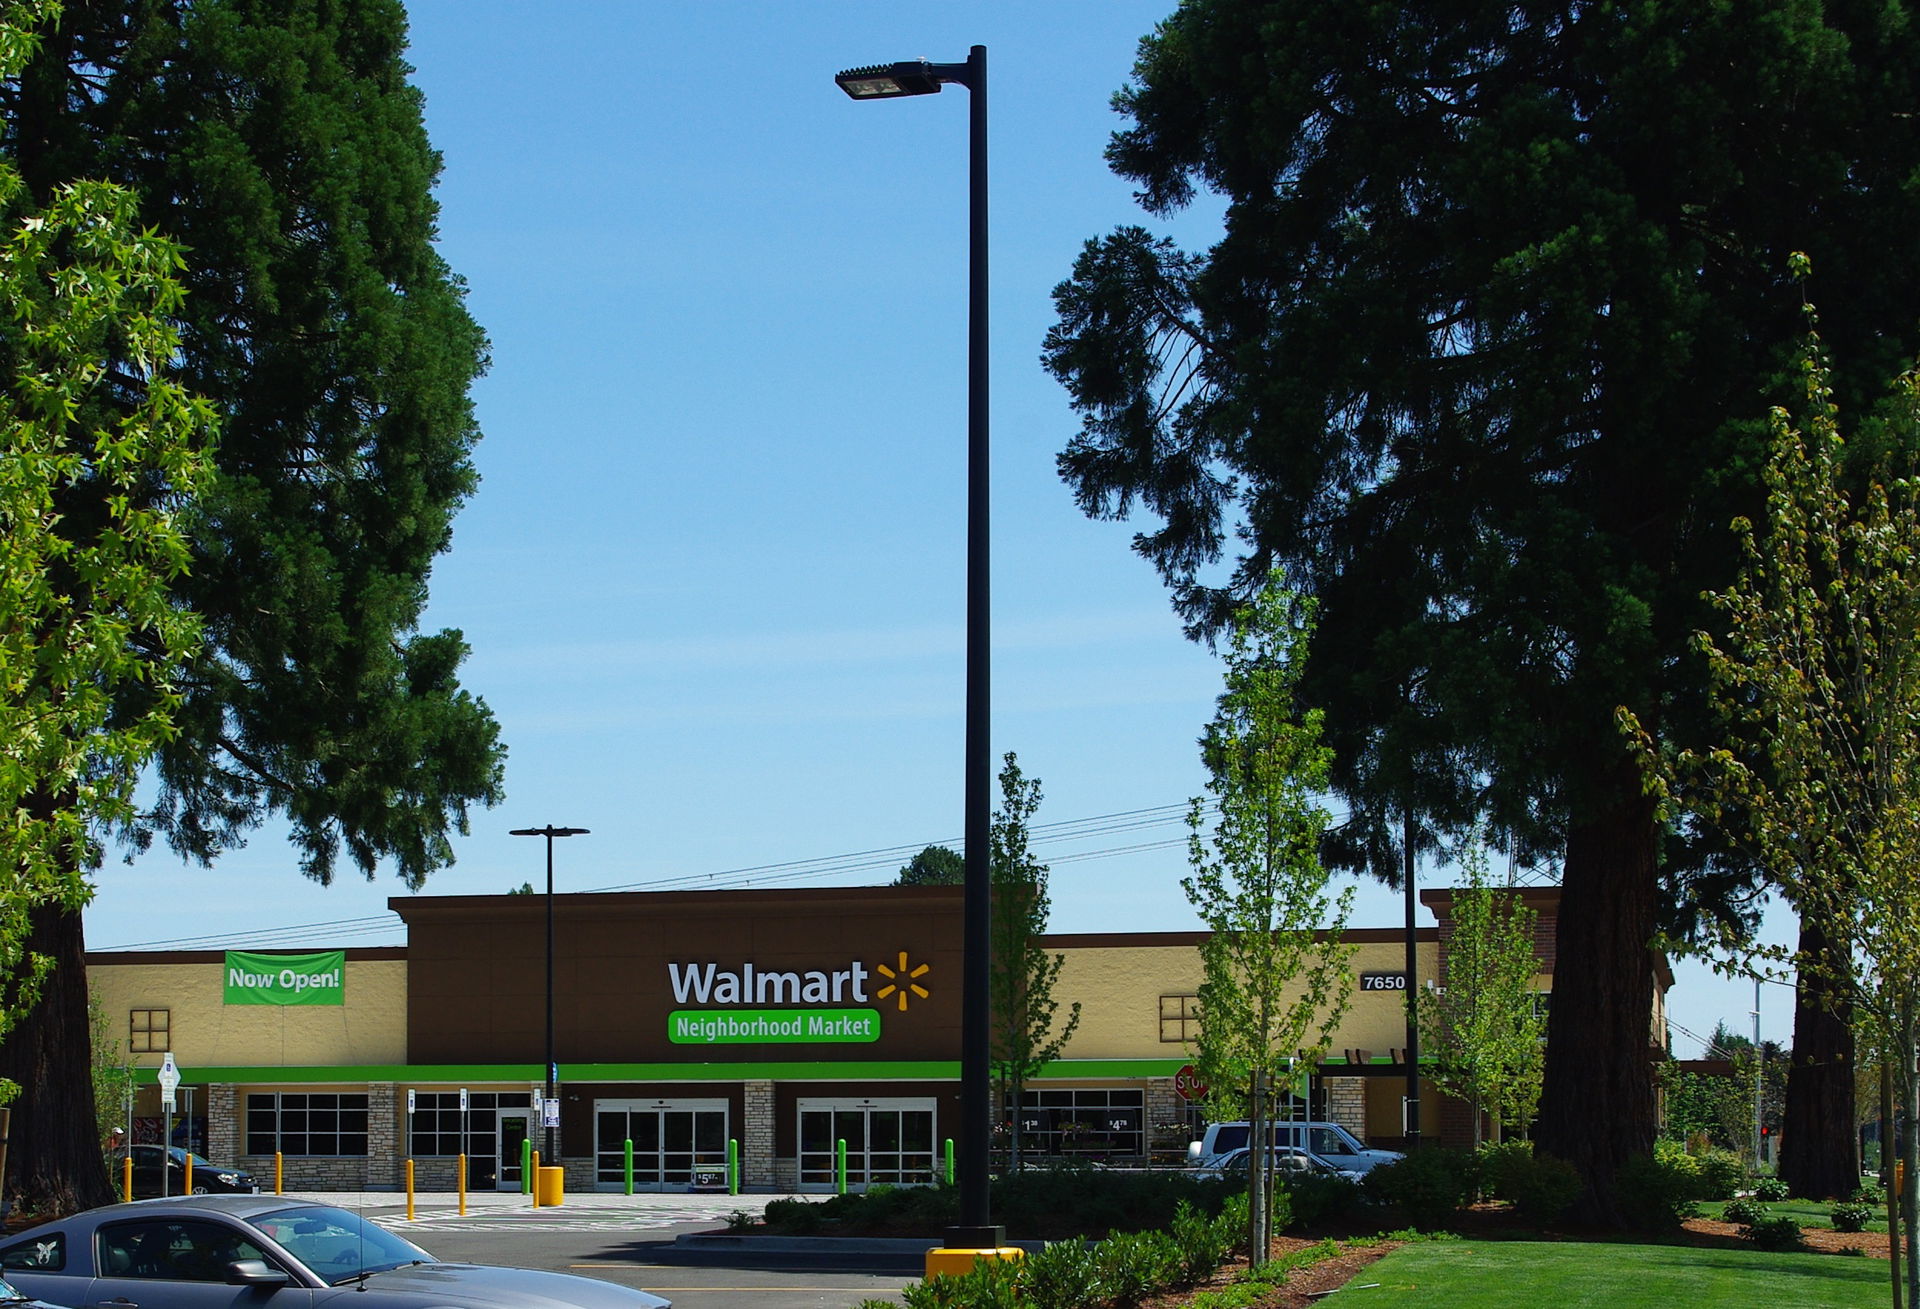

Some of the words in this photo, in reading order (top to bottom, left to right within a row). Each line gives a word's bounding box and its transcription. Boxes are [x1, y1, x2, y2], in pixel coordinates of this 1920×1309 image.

[229, 968, 275, 988] Now
[279, 968, 340, 993] Open!
[668, 961, 869, 1004] Walmart
[1364, 976, 1405, 989] 7650
[677, 1016, 802, 1042] Neighborhood
[808, 1016, 871, 1036] Market
